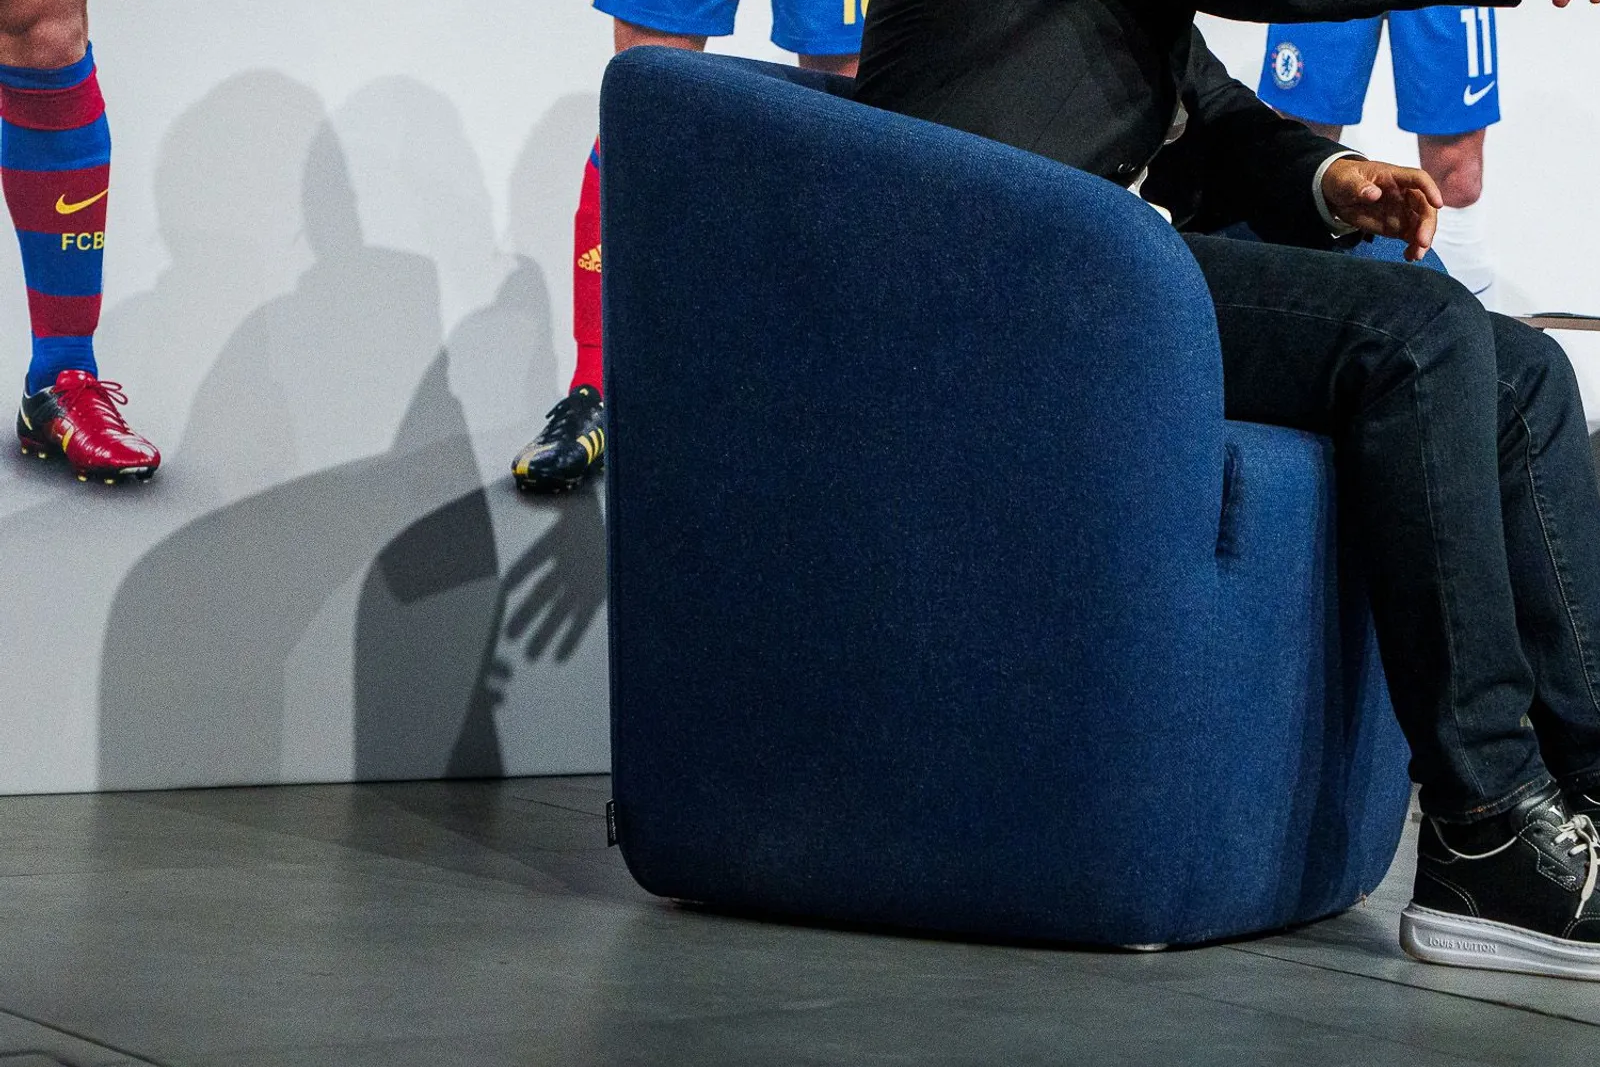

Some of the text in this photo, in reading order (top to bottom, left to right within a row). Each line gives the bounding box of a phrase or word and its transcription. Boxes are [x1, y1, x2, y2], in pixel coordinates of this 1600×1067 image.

[1461, 6, 1493, 78] 11
[62, 231, 104, 251] FCB
[1428, 937, 1498, 954] LOUIS VUITTON
